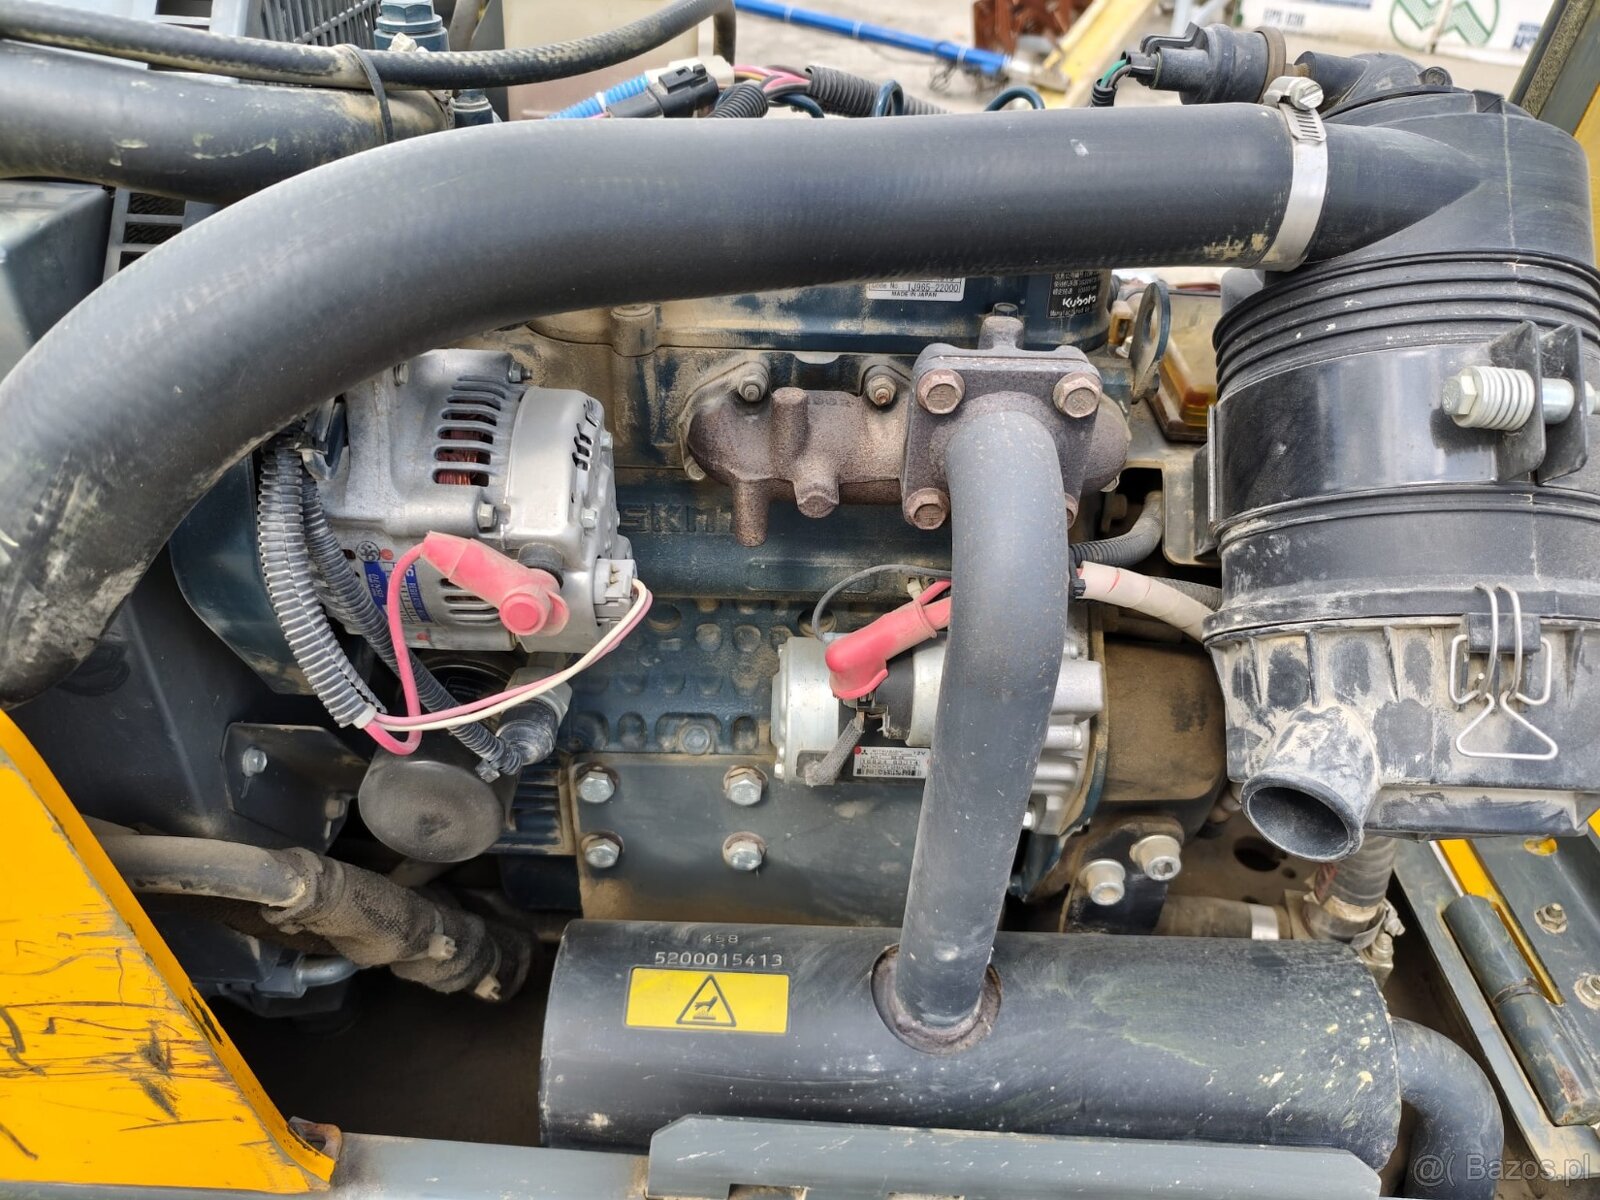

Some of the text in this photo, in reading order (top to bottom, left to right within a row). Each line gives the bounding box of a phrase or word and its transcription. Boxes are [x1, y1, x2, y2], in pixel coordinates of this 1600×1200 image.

[908, 283, 959, 293] 1J965-22000
[1062, 294, 1097, 308] Kubota
[655, 951, 783, 967] 5200015413
